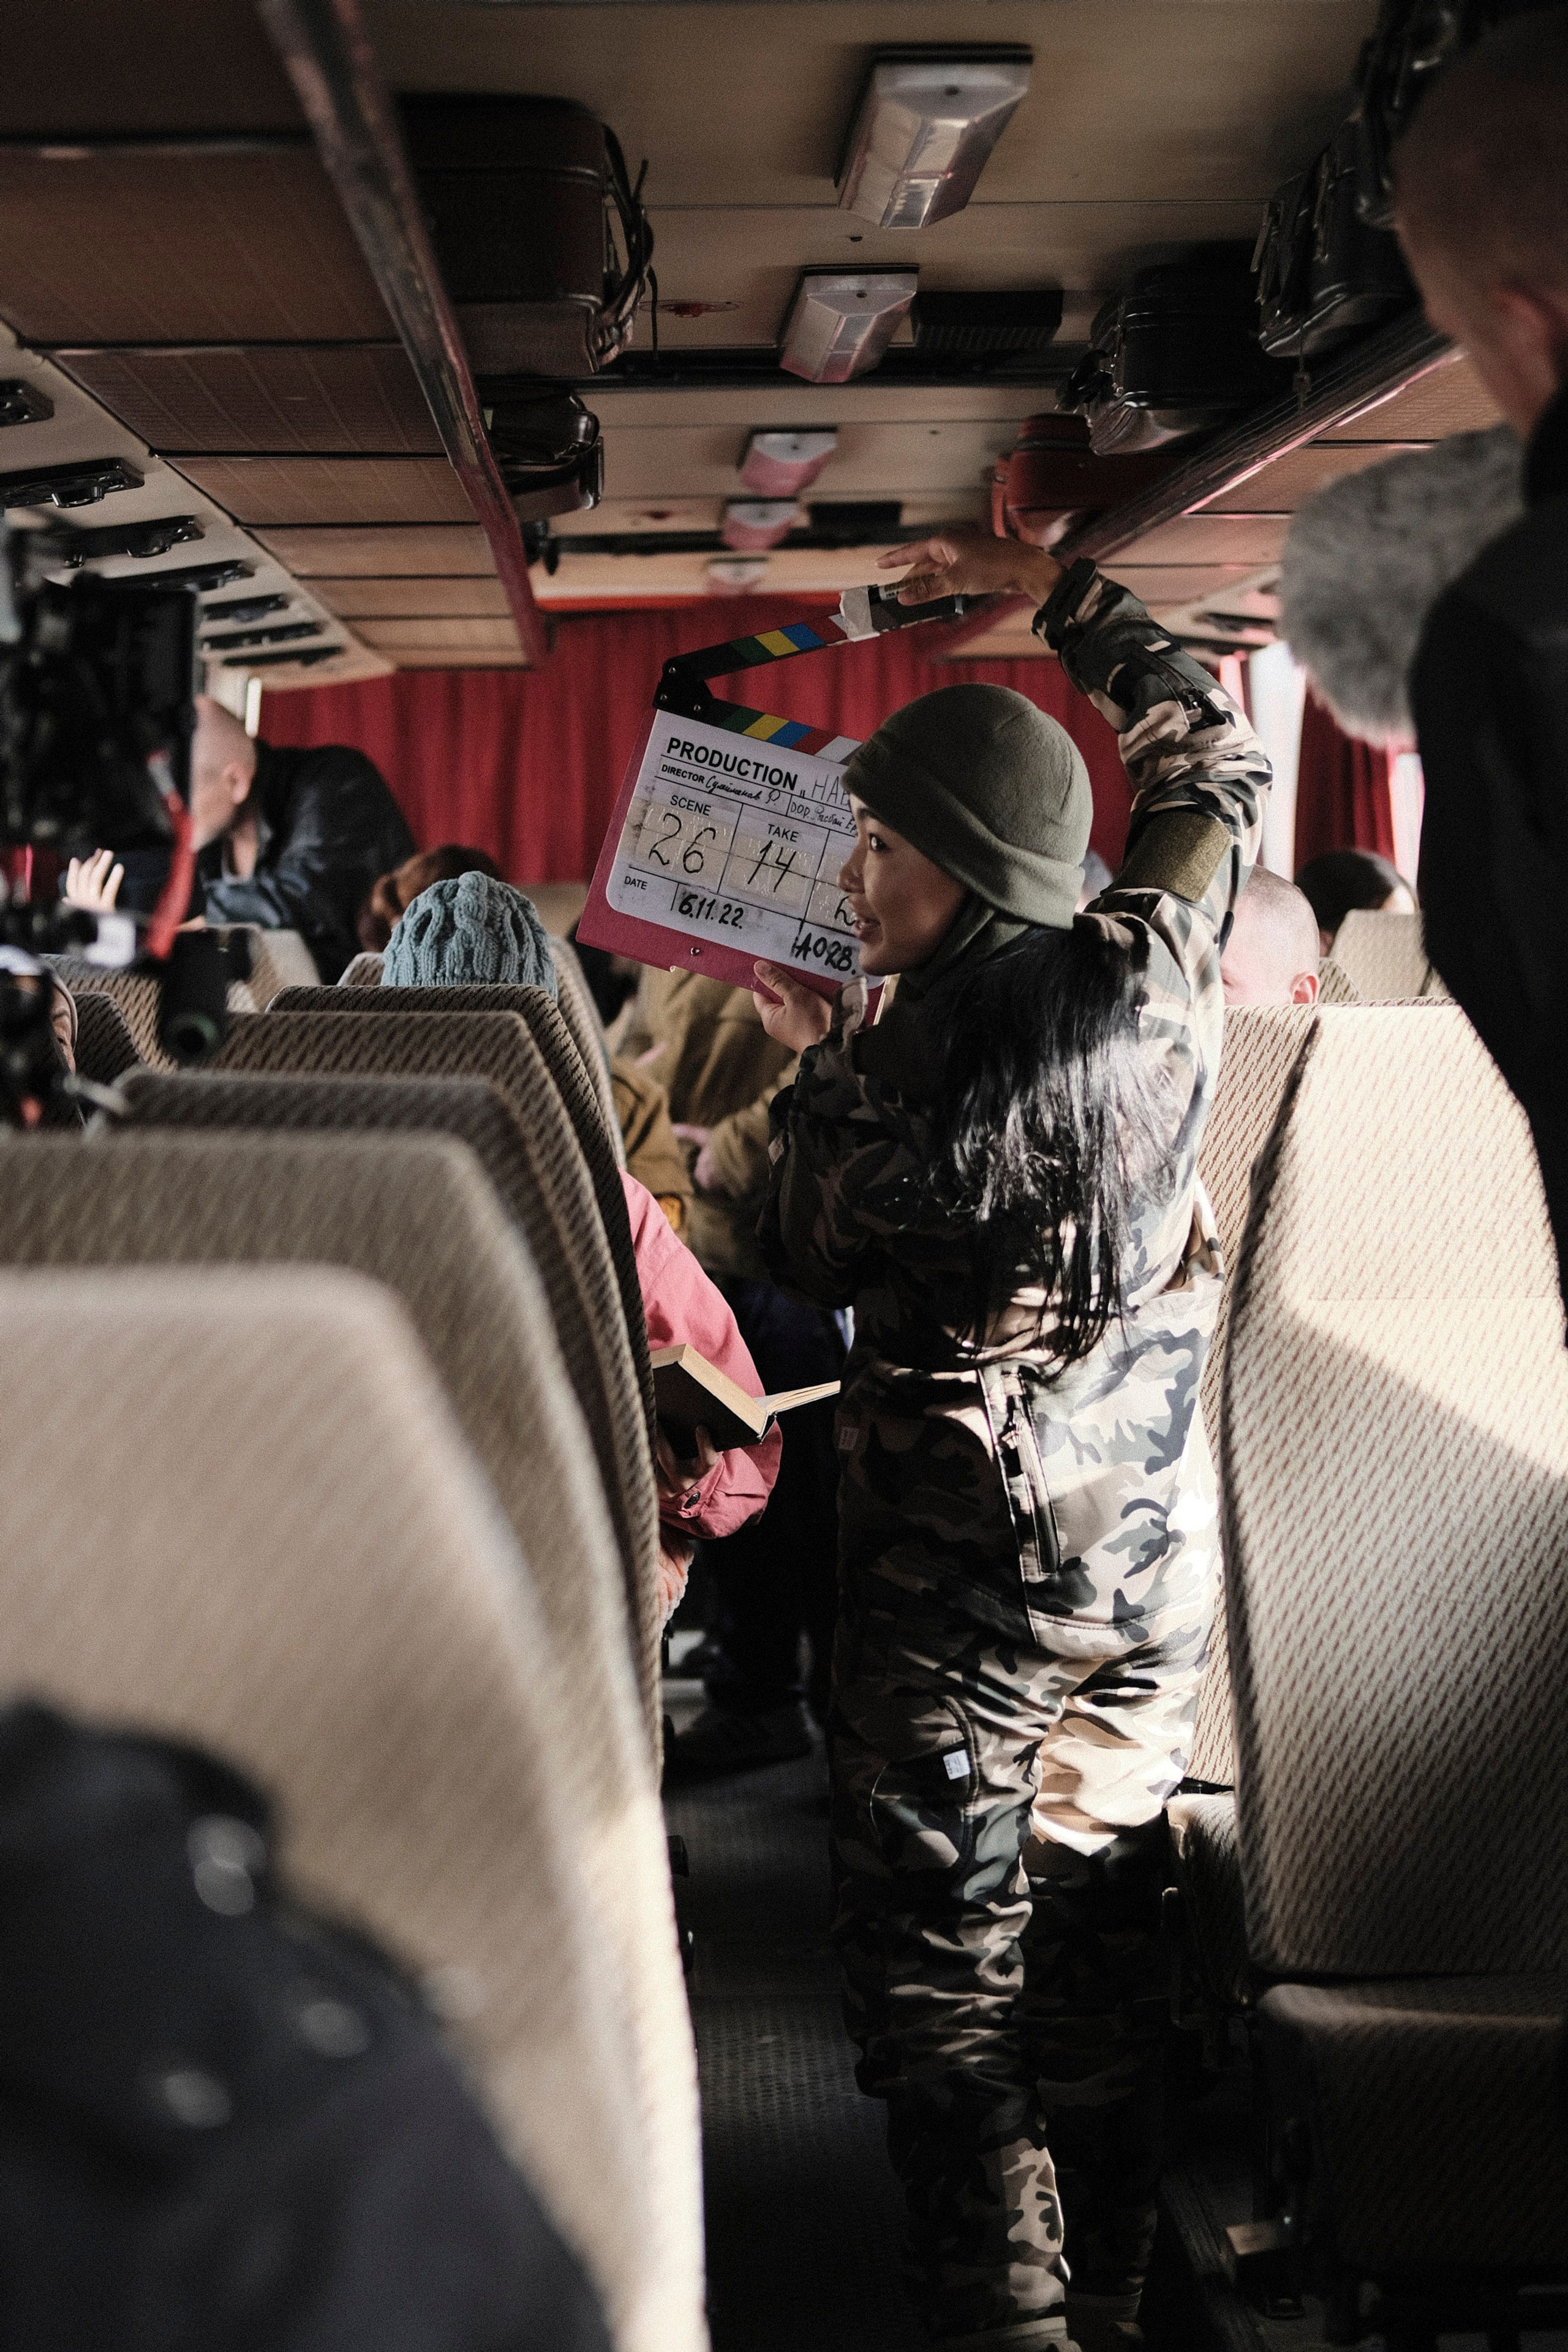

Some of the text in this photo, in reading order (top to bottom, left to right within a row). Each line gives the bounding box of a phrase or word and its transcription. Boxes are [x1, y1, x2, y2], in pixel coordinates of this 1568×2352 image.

[661, 764, 705, 784] DIRECTOR
[666, 737, 798, 791] PRODUCTION
[669, 795, 712, 816] SCENE
[648, 812, 717, 874] 26
[767, 823, 799, 842] TAKE
[747, 840, 797, 892] 14
[624, 875, 648, 890] DATE
